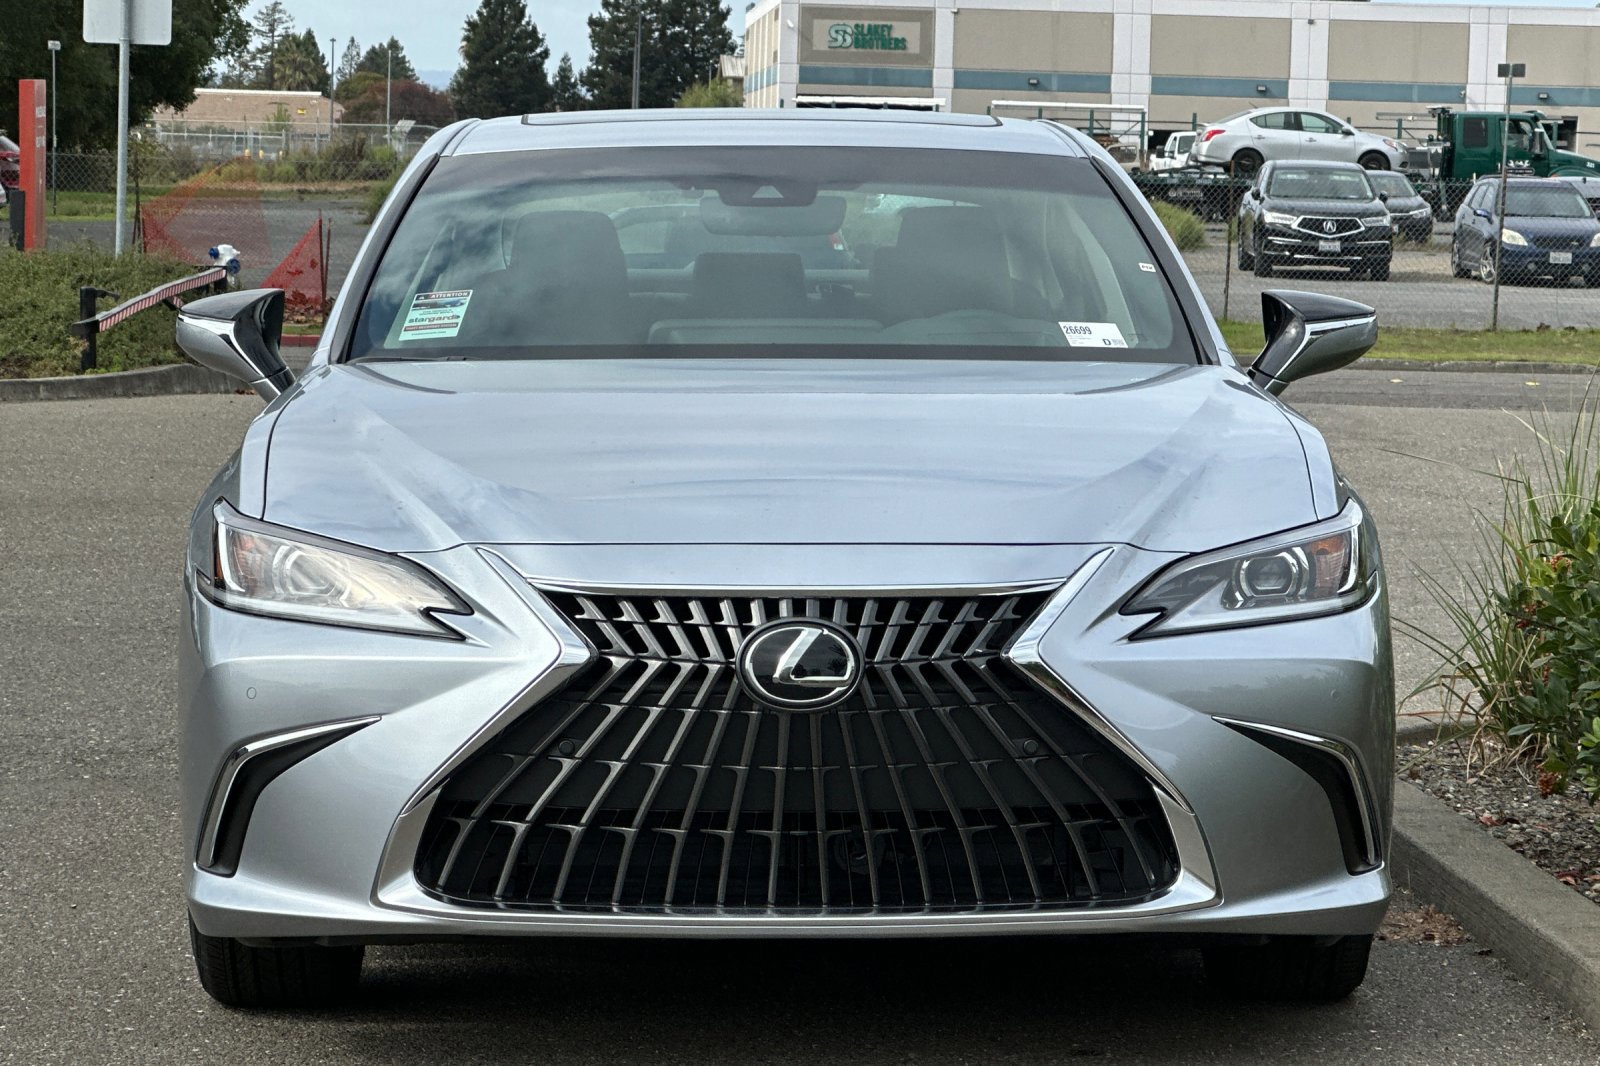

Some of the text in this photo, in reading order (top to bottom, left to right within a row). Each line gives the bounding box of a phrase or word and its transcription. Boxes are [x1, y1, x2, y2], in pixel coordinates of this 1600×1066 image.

[854, 23, 893, 37] SLAKEY
[854, 36, 907, 50] BROTHERS
[1063, 325, 1093, 335] 26699
